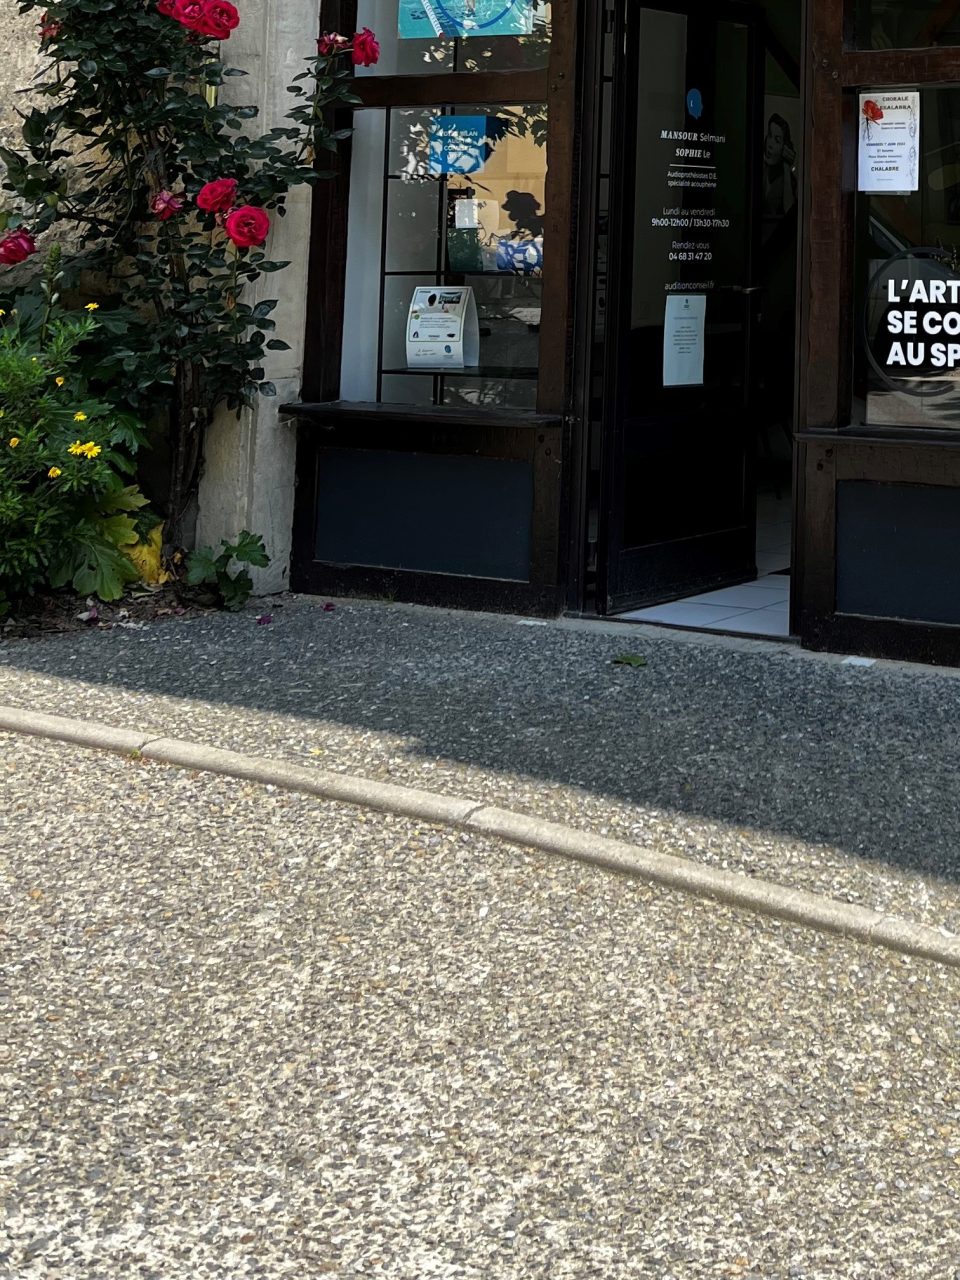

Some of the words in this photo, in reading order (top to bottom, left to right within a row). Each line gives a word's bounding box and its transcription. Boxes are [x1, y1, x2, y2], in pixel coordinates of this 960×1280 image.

[660, 129, 698, 141] MANSOUR
[699, 132, 726, 143] Selmani
[675, 148, 703, 158] SOPHIE
[703, 150, 711, 159] Le
[662, 207, 680, 216] Lundi
[690, 208, 716, 216] vendredi
[651, 218, 689, 227] 9h00-12h00
[693, 218, 730, 228] 13h30-17h30
[668, 252, 678, 261] 04
[678, 252, 687, 261] 68
[687, 252, 694, 261] 31
[695, 252, 704, 261] 47
[703, 252, 713, 261] 20
[664, 280, 715, 291] auditionconseil.fr
[887, 311, 917, 335] SE
[886, 342, 925, 366] AU
